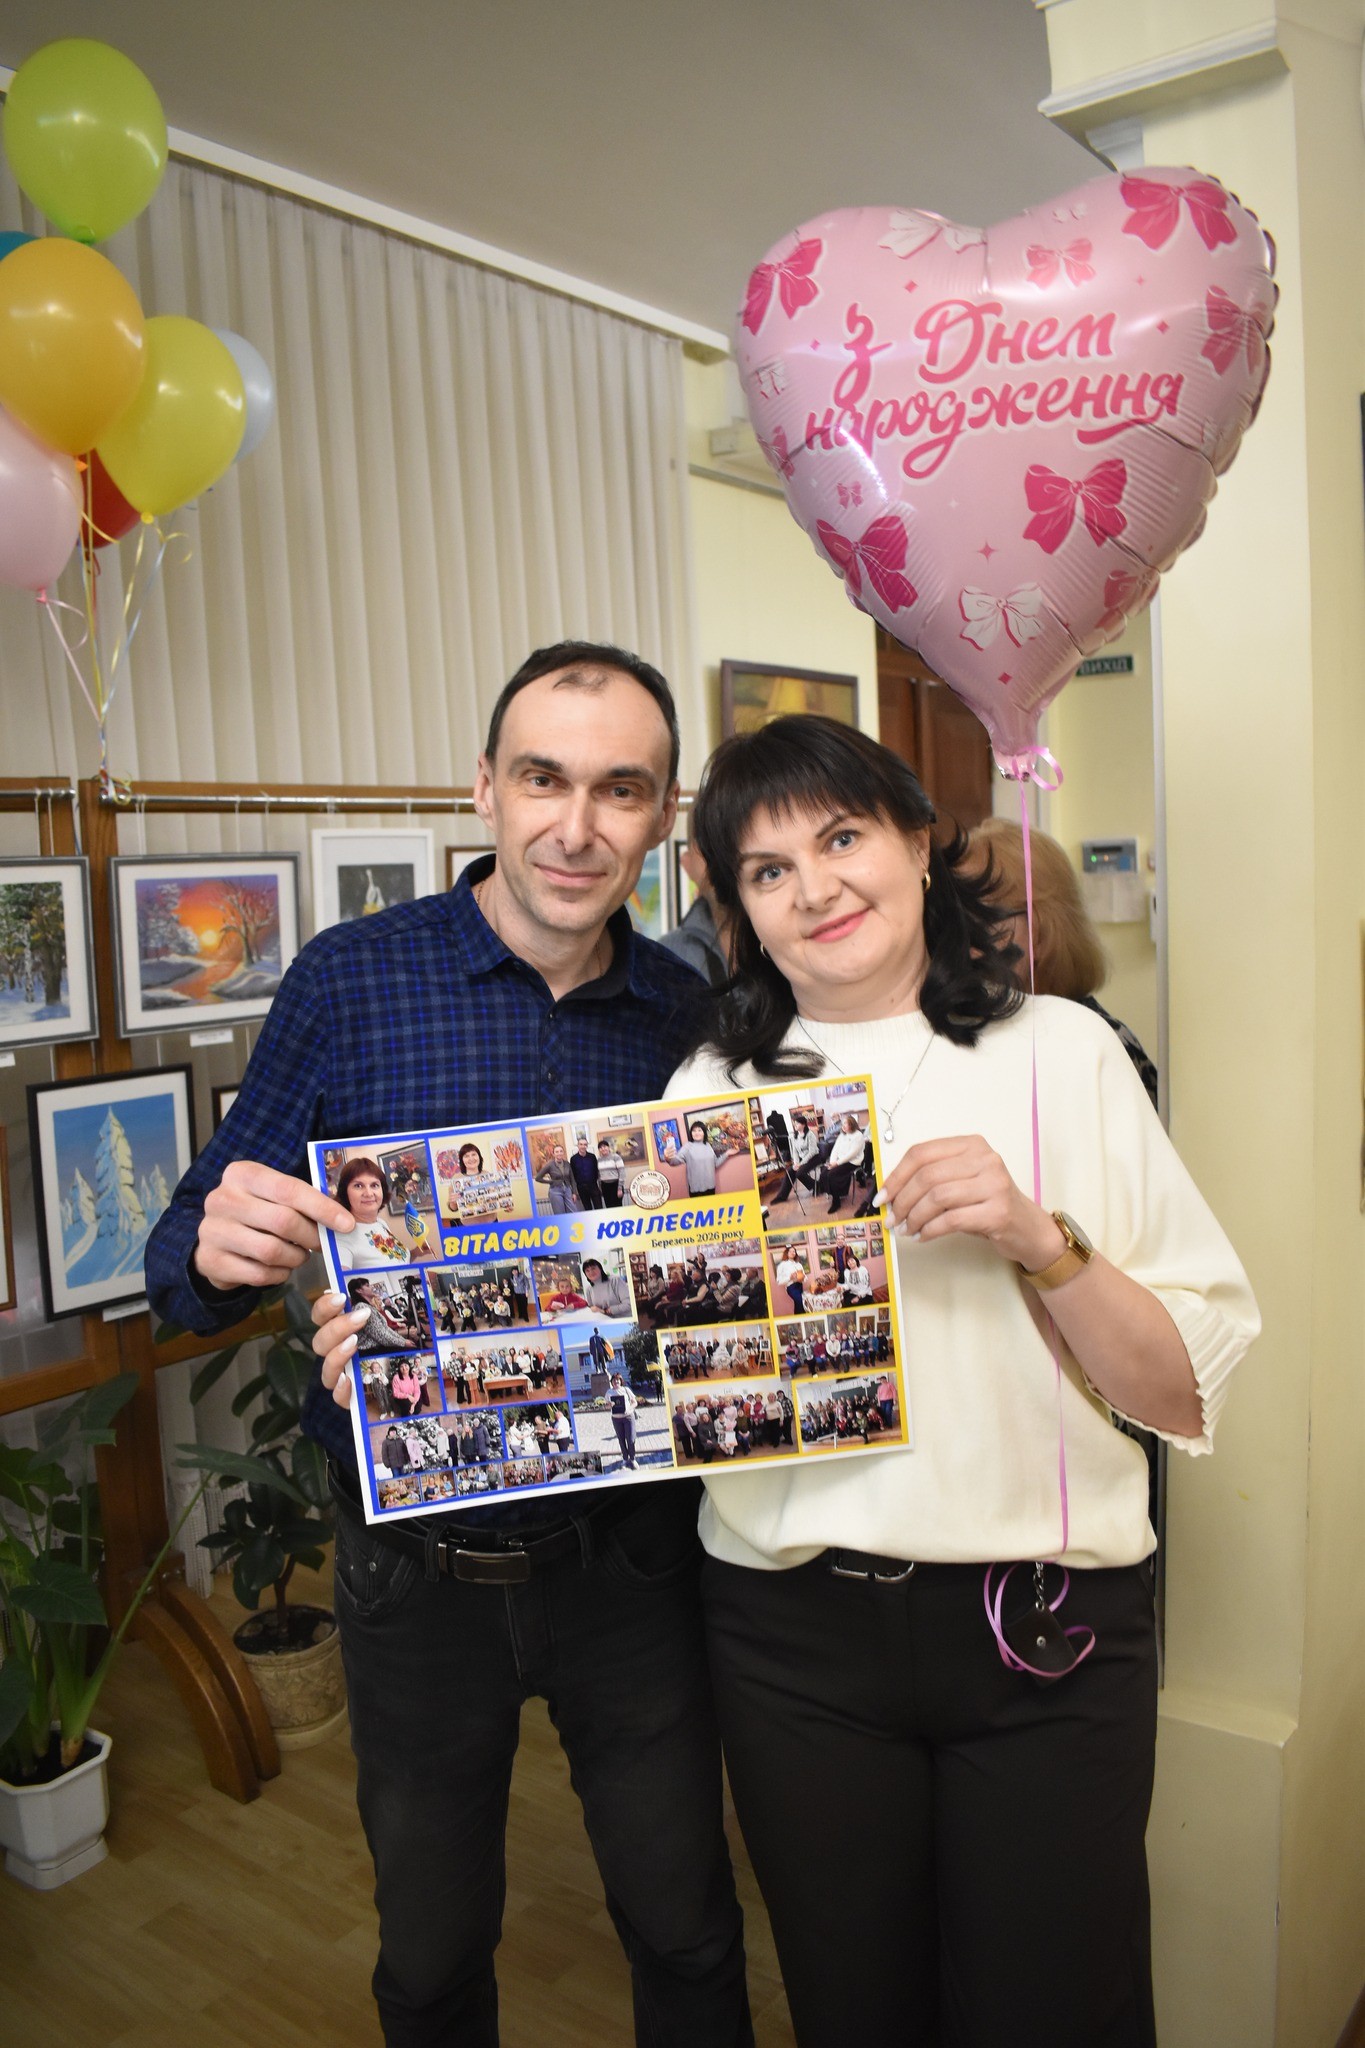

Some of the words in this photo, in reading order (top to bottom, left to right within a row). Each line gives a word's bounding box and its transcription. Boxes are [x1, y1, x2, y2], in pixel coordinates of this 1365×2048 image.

[834, 302, 892, 409] з
[914, 299, 1116, 384] Днем
[805, 372, 1184, 479] народження
[443, 1225, 560, 1257] ВІТАЄМО
[569, 1222, 585, 1243] З
[596, 1205, 745, 1239] ЮВІЛЕЄМ!!!
[651, 1236, 695, 1248] Березень
[697, 1231, 720, 1243] 2026
[721, 1230, 745, 1242] року
